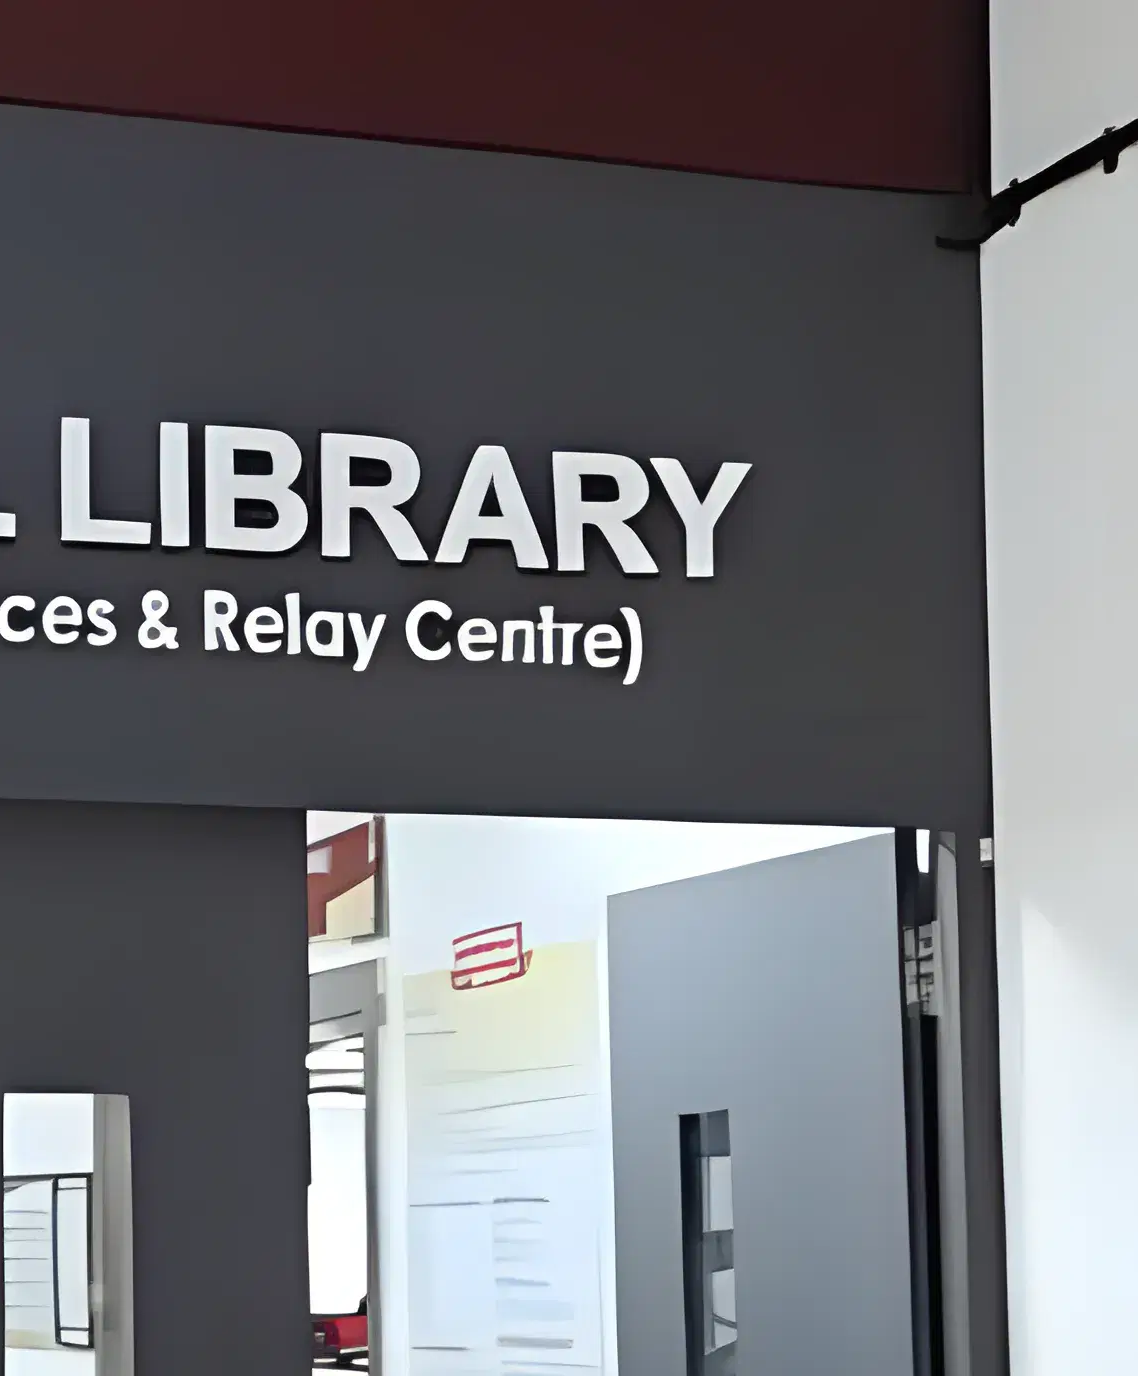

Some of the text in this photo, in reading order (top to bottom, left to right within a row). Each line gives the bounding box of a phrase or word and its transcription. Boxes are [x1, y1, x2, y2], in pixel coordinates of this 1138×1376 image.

[59, 416, 753, 578] LIBRARY
[137, 589, 180, 650] &
[203, 589, 387, 672] Relay
[405, 599, 643, 686] Centre)
